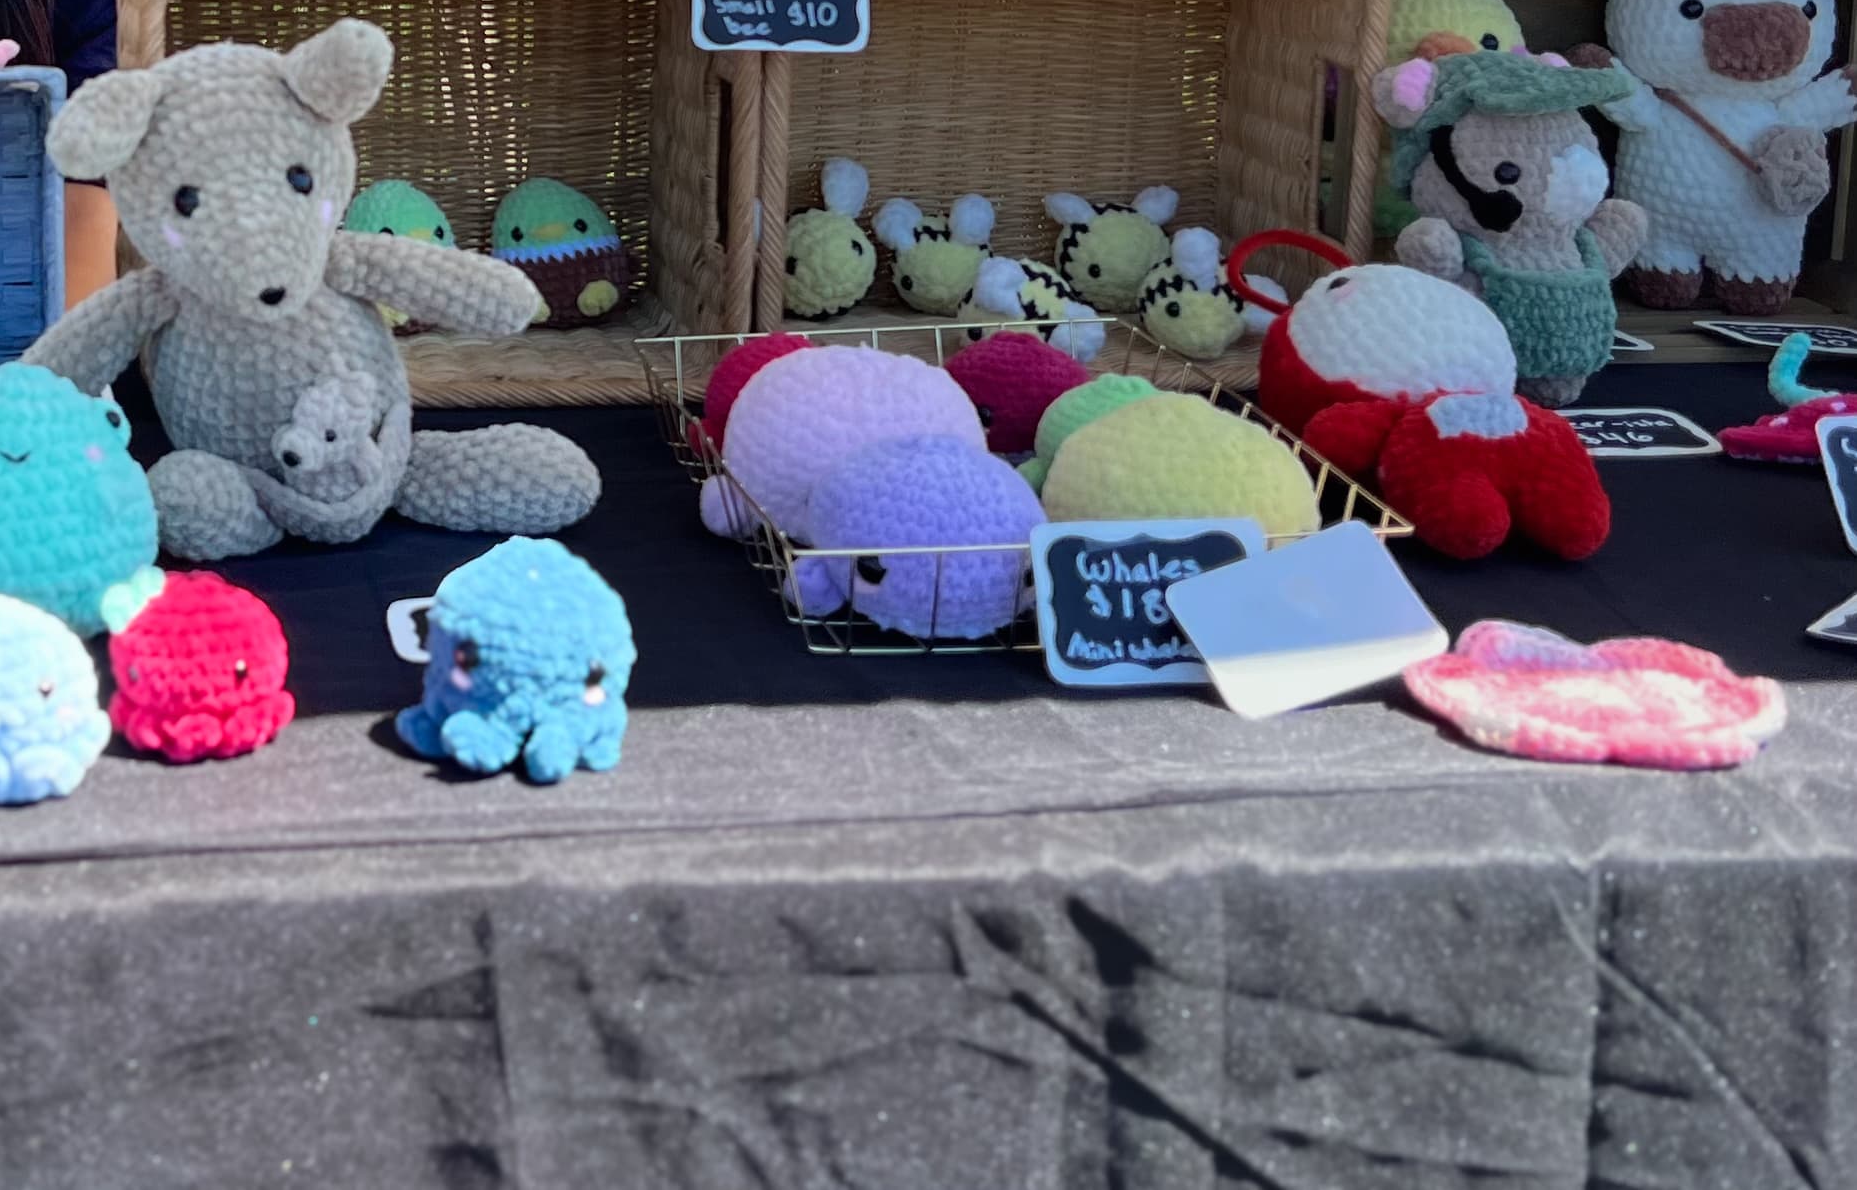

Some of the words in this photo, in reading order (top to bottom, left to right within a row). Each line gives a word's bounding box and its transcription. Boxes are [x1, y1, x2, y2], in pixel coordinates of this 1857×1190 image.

[787, 1, 839, 28] $10
[1076, 551, 1201, 584] Whales
[1085, 584, 1171, 625] $18
